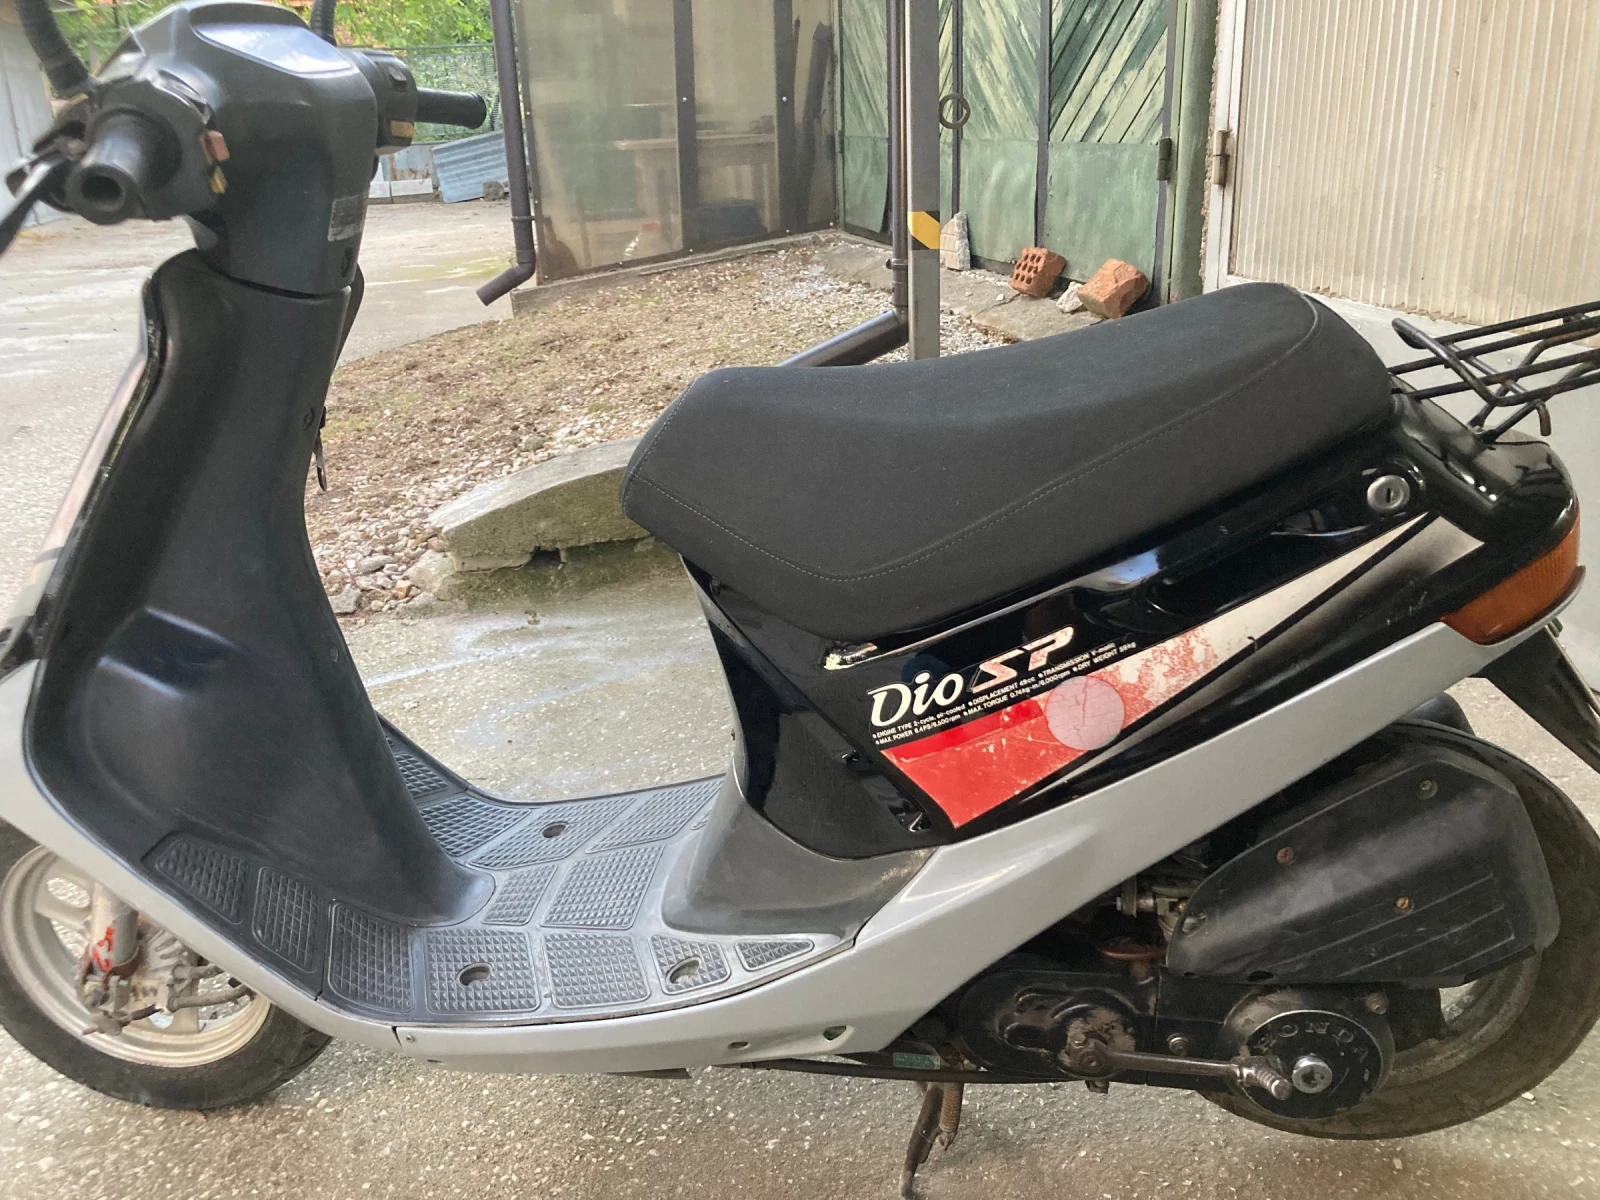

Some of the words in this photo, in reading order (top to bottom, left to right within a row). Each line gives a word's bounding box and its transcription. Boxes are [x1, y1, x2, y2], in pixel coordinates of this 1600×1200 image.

[867, 672, 963, 726] Dio
[971, 626, 1074, 694] SP
[876, 727, 897, 738] ENGINE
[897, 722, 913, 733] TYPE
[972, 682, 1018, 706] DISPLACEMENT
[1042, 652, 1090, 677] TRANSMISSION
[893, 729, 913, 741] POWER
[983, 694, 1008, 709] TORQUE
[1077, 660, 1091, 671] DRY
[1092, 648, 1118, 664] WEIGHT
